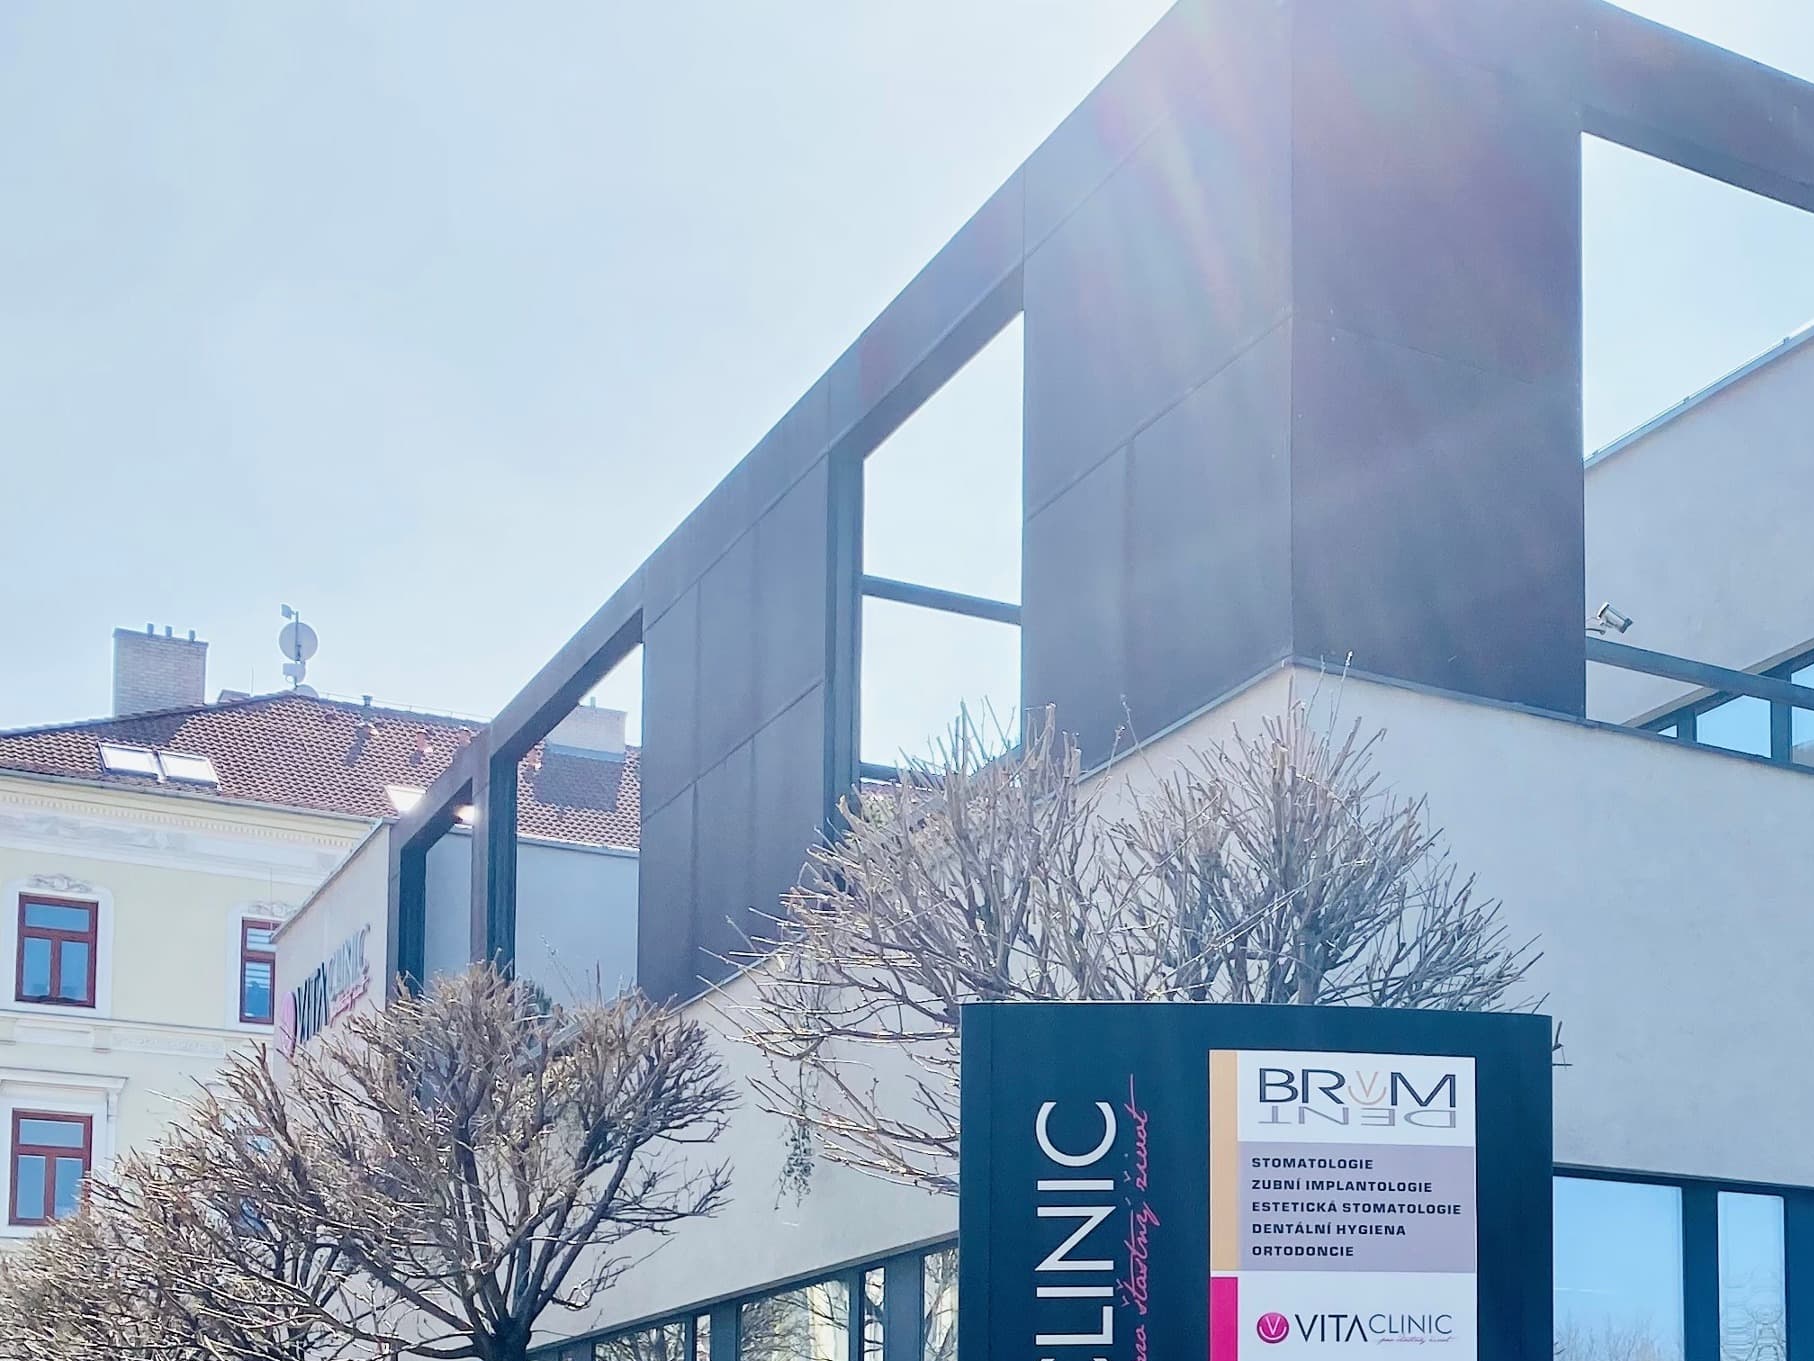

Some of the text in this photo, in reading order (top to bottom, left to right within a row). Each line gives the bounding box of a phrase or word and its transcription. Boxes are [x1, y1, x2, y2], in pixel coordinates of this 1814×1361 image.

[1251, 1157, 1374, 1170] STOMATOLOGIE
[1251, 1177, 1433, 1193] ZUBNÍ IMPLANTOLOGIE
[1251, 1200, 1462, 1215] ESTETICKÁ STOMATOLOGIE
[1251, 1221, 1407, 1236] DENTÁLNÍ HYGIENA
[1251, 1245, 1354, 1257] ORTODONCIE
[1294, 1313, 1453, 1343] VITACLINIC
